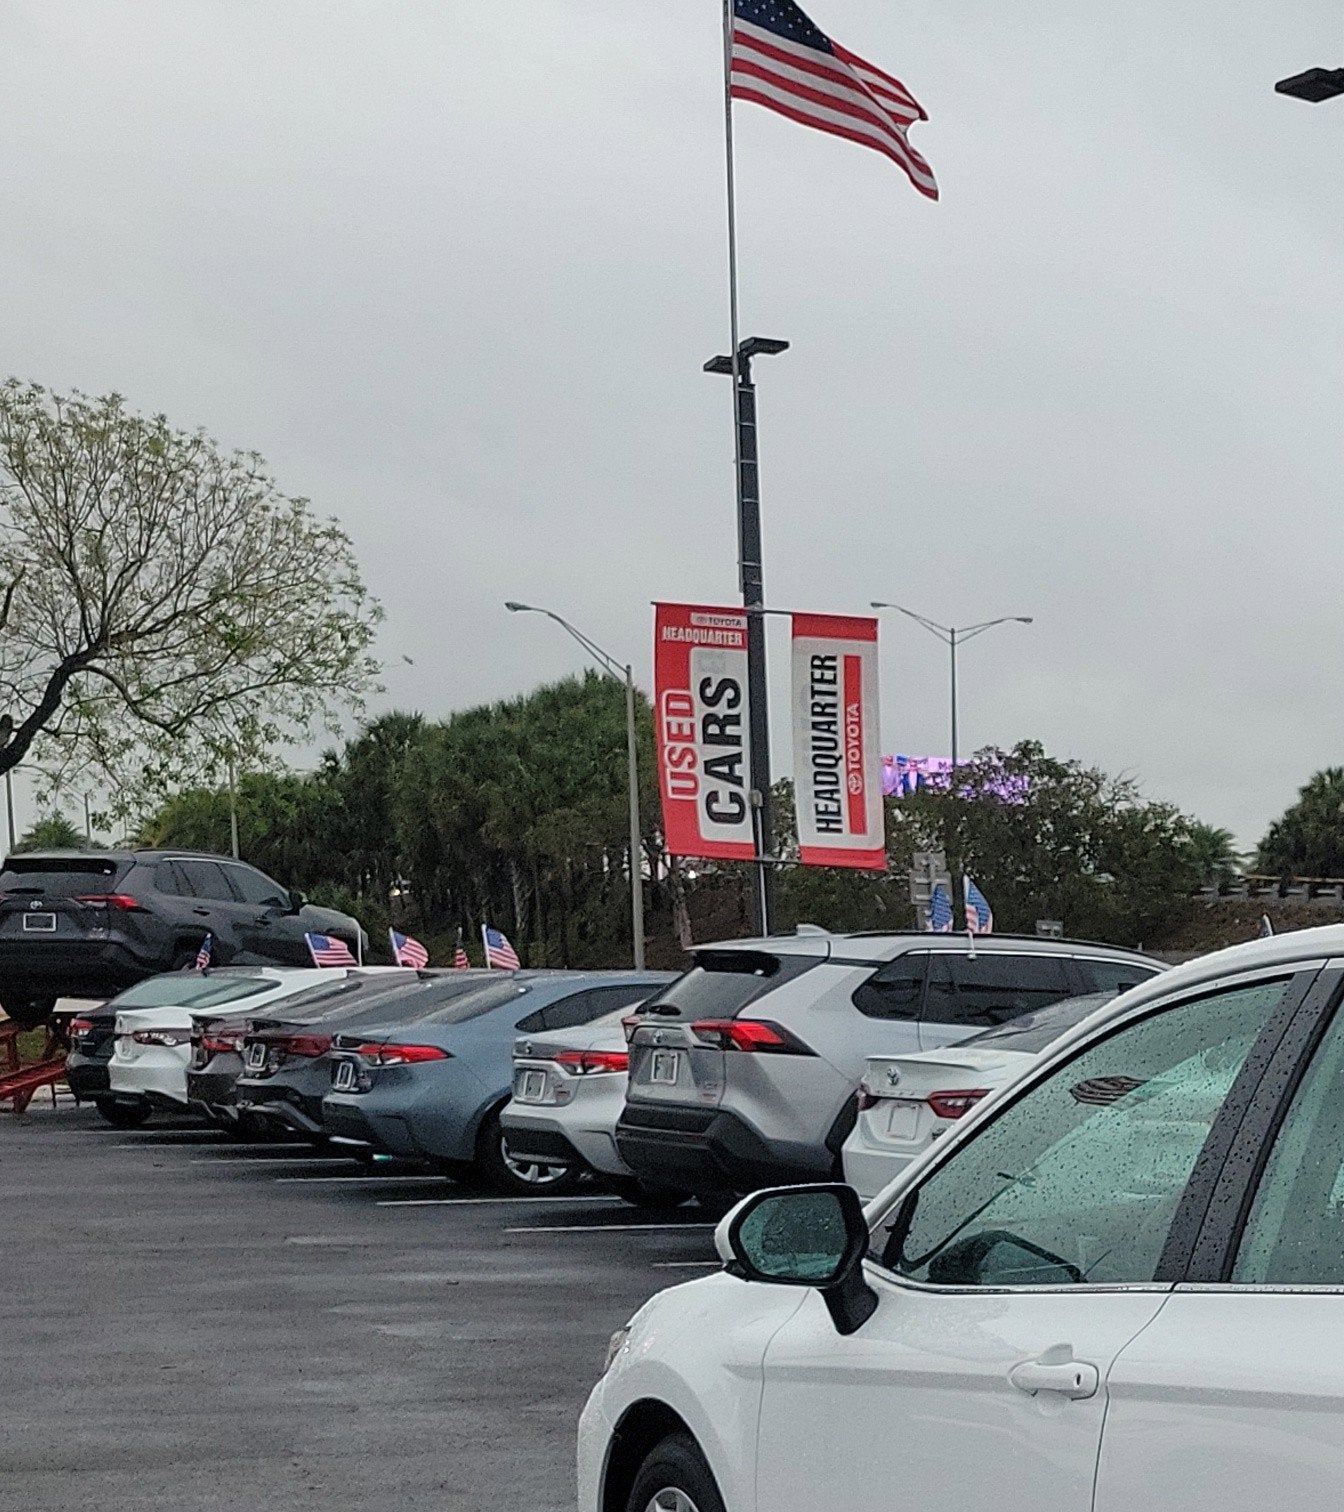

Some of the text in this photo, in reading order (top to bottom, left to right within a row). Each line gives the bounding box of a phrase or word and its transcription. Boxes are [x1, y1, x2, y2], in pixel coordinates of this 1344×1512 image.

[662, 626, 742, 646] HEADQUARTER
[709, 616, 742, 627] TOYOTA
[662, 689, 700, 800] USED
[699, 676, 746, 825] CARS
[810, 654, 843, 834] HEADQUARTER
[845, 703, 861, 772] TOYOTA
